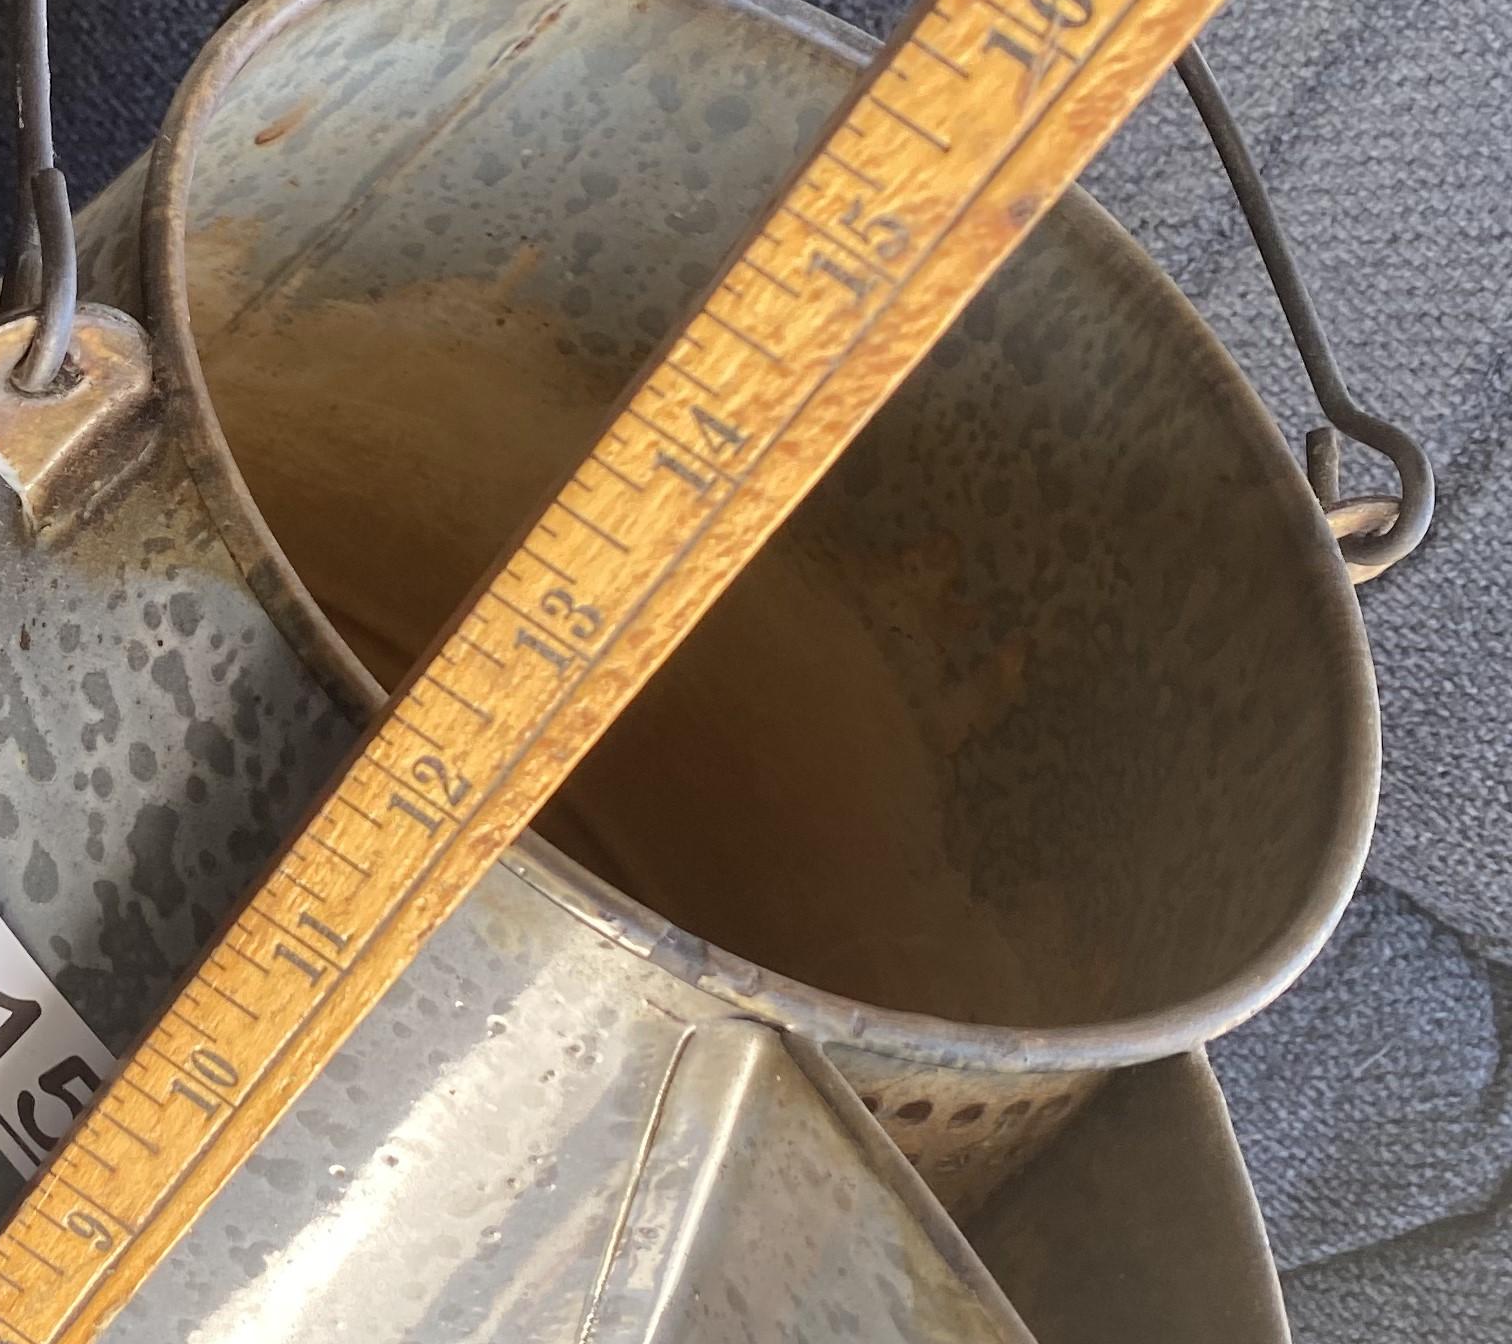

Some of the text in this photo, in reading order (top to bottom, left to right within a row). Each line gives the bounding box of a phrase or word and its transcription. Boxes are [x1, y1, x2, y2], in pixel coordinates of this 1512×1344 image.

[804, 199, 912, 306] 15
[654, 404, 753, 502] 14
[514, 586, 604, 678] 13
[389, 755, 473, 838] 12
[273, 911, 353, 988] 11
[170, 1048, 239, 1121] 10
[65, 1209, 114, 1254] 9
